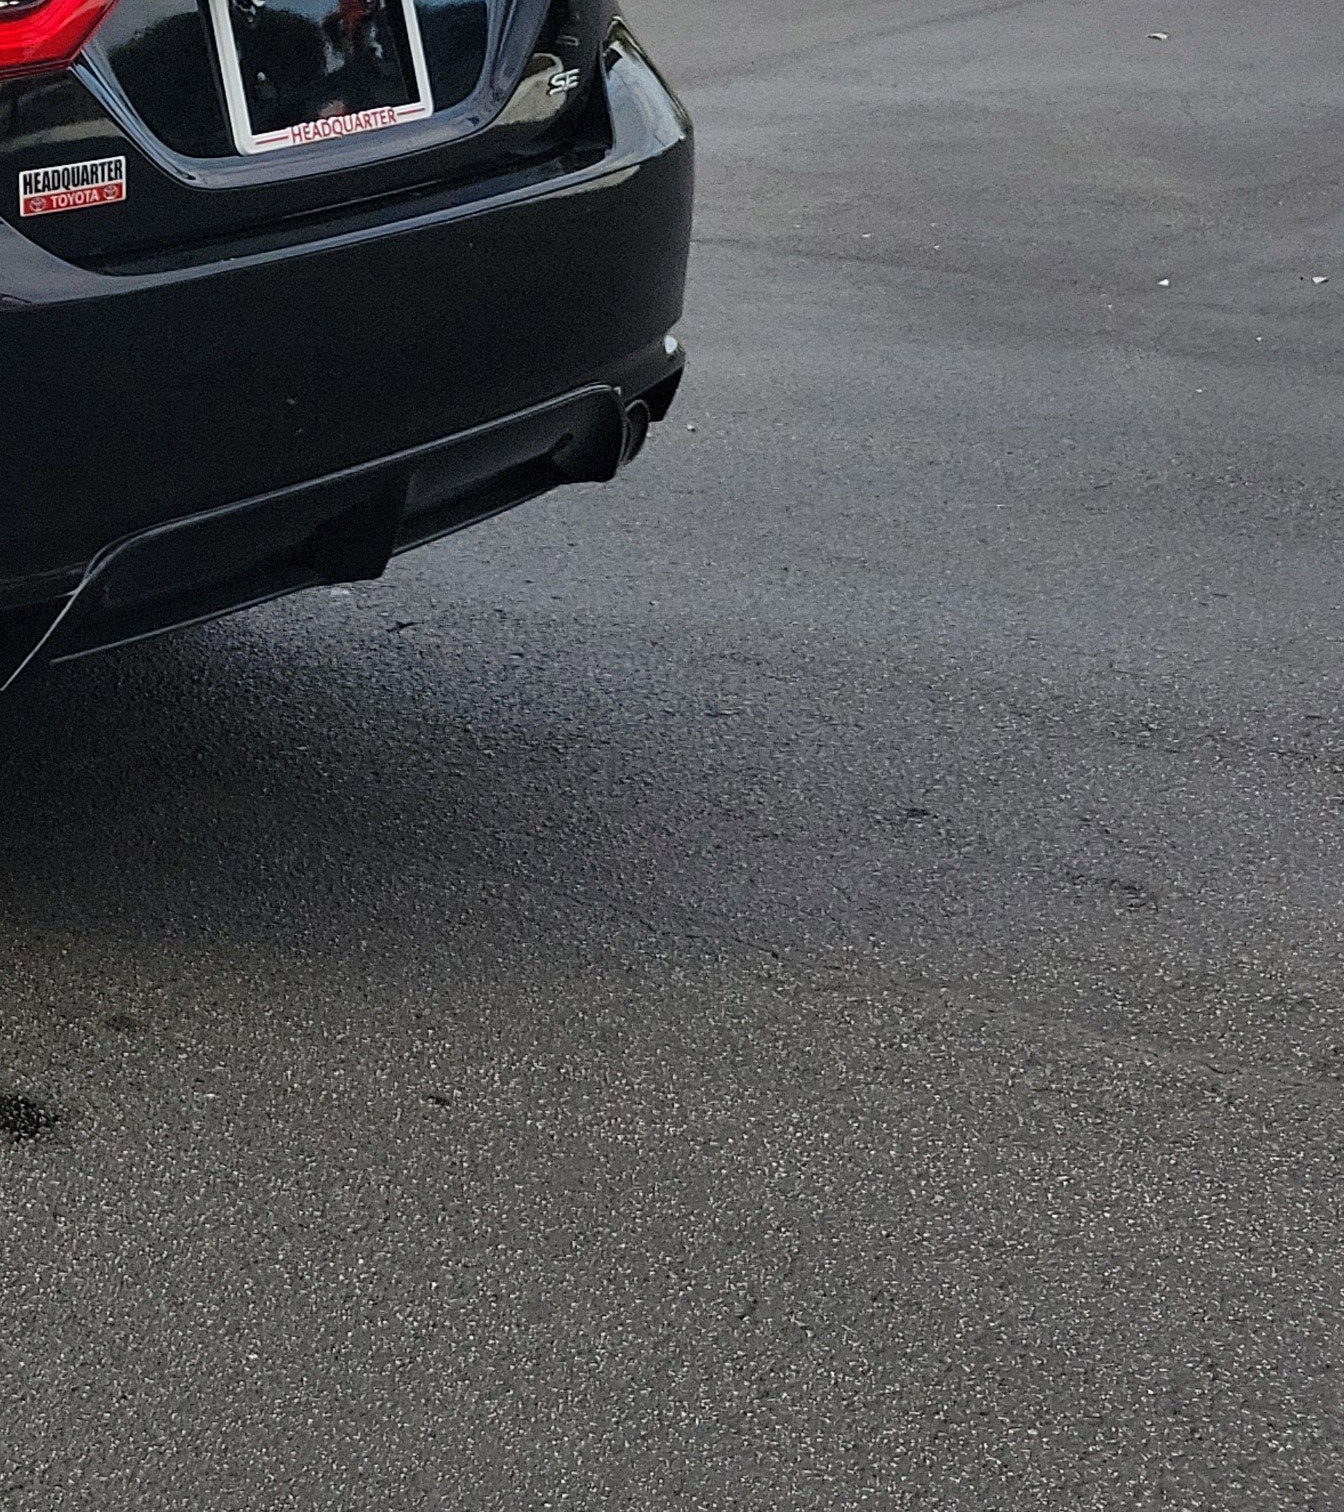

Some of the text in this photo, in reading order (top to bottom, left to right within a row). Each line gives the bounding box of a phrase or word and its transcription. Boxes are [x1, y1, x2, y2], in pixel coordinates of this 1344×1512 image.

[549, 68, 579, 95] SE
[291, 108, 397, 143] HEADQUARTER
[22, 159, 123, 195] HEADQUARTER
[50, 189, 100, 208] TOYOTA
